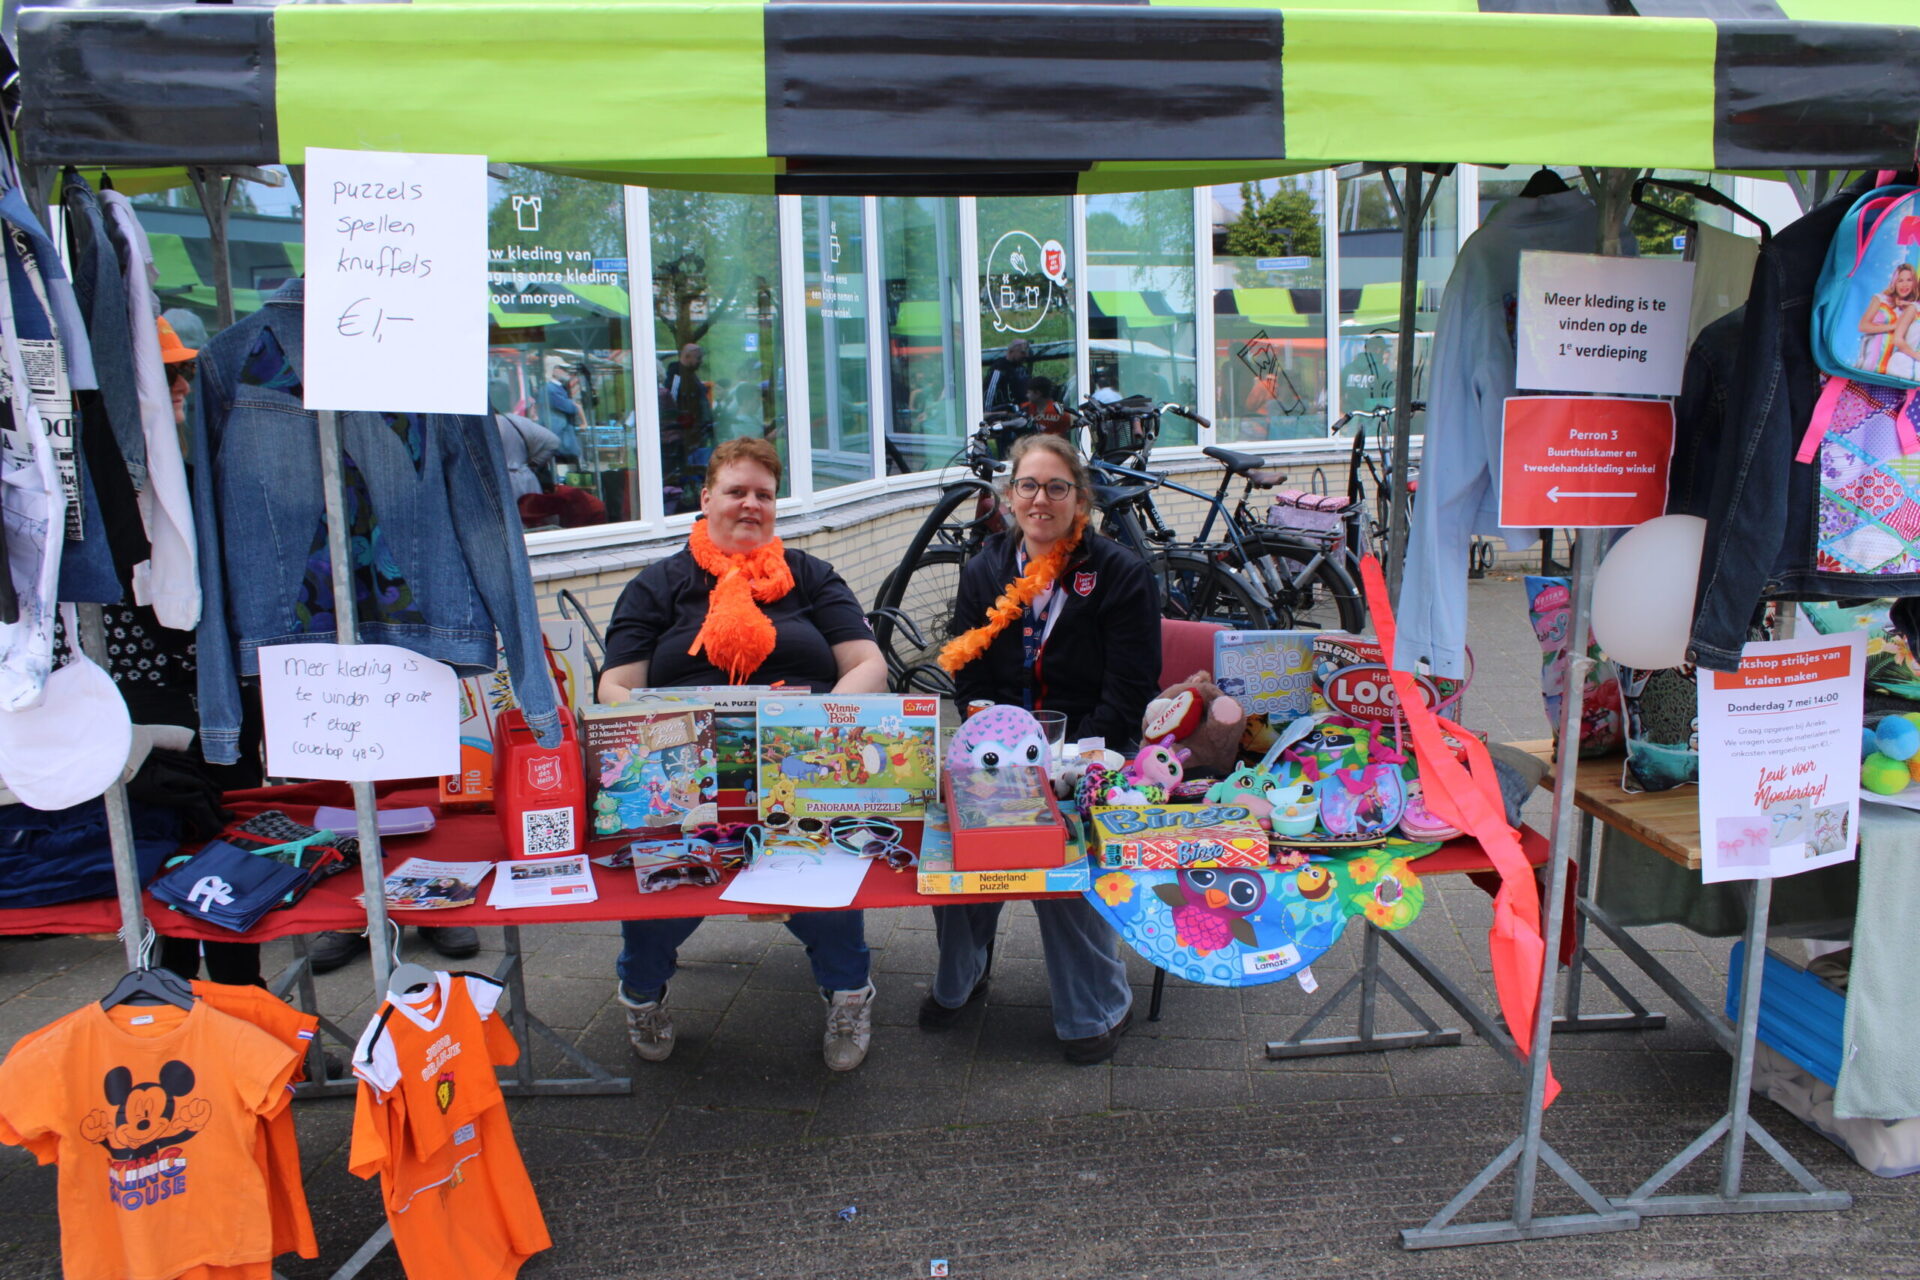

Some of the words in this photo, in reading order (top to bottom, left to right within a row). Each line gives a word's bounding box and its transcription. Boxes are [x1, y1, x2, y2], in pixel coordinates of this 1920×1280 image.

[333, 181, 423, 204] puzzels
[337, 245, 432, 278] knuffels
[508, 245, 563, 264] kleding
[566, 250, 591, 261] van
[512, 268, 524, 281] is
[529, 271, 562, 282] onze
[566, 268, 618, 285] kleding
[488, 294, 517, 304] oor
[521, 293, 580, 307] morgen.
[1544, 292, 1581, 306] Meer
[1585, 294, 1634, 312] kleding
[1638, 297, 1648, 310] is
[1652, 299, 1666, 311] te
[1559, 317, 1605, 332] vinden
[1609, 322, 1626, 335] op
[1630, 320, 1648, 334] de
[1559, 343, 1572, 356] 1e
[1575, 345, 1648, 363] verdieping
[1569, 428, 1608, 440] Perron
[1611, 430, 1618, 440] 3
[1547, 447, 1623, 457] Buurthuiskamer
[1626, 450, 1638, 458] en
[1523, 463, 1624, 475] tweedehandskleding
[1626, 464, 1656, 474] winkel
[1221, 645, 1302, 677] Reisje
[1738, 658, 1779, 670] rkshop
[1781, 653, 1820, 667] strikjes
[1822, 651, 1841, 660] van
[337, 658, 392, 685] kleding
[1372, 673, 1393, 683] Het
[1744, 675, 1781, 686] kralen
[1784, 671, 1818, 682] maken
[1245, 671, 1313, 696] Boom
[296, 686, 312, 701] te
[384, 692, 400, 708] op
[1239, 689, 1313, 716] Beestj
[1727, 701, 1785, 713] Donderdag
[1787, 699, 1793, 708] 7
[1795, 697, 1812, 706] mei
[1814, 692, 1839, 704] 14:00
[823, 703, 861, 714] Winnie
[915, 703, 934, 712] Trefl
[1351, 704, 1409, 719] BORDSE
[829, 712, 856, 724] Pooh
[327, 718, 361, 743] etage
[1738, 727, 1762, 736] Graag
[1758, 764, 1787, 790] Leuk
[1791, 760, 1816, 776] voor
[1754, 774, 1828, 810] Moederdag!
[806, 803, 861, 812] PANORAMA
[863, 803, 901, 811] PUZZLE
[1094, 805, 1250, 835] Bingo
[1177, 842, 1225, 866] Bingo
[979, 882, 1010, 892] puzzle
[1254, 958, 1288, 970] Lamaze
[107, 1146, 187, 1191] KING
